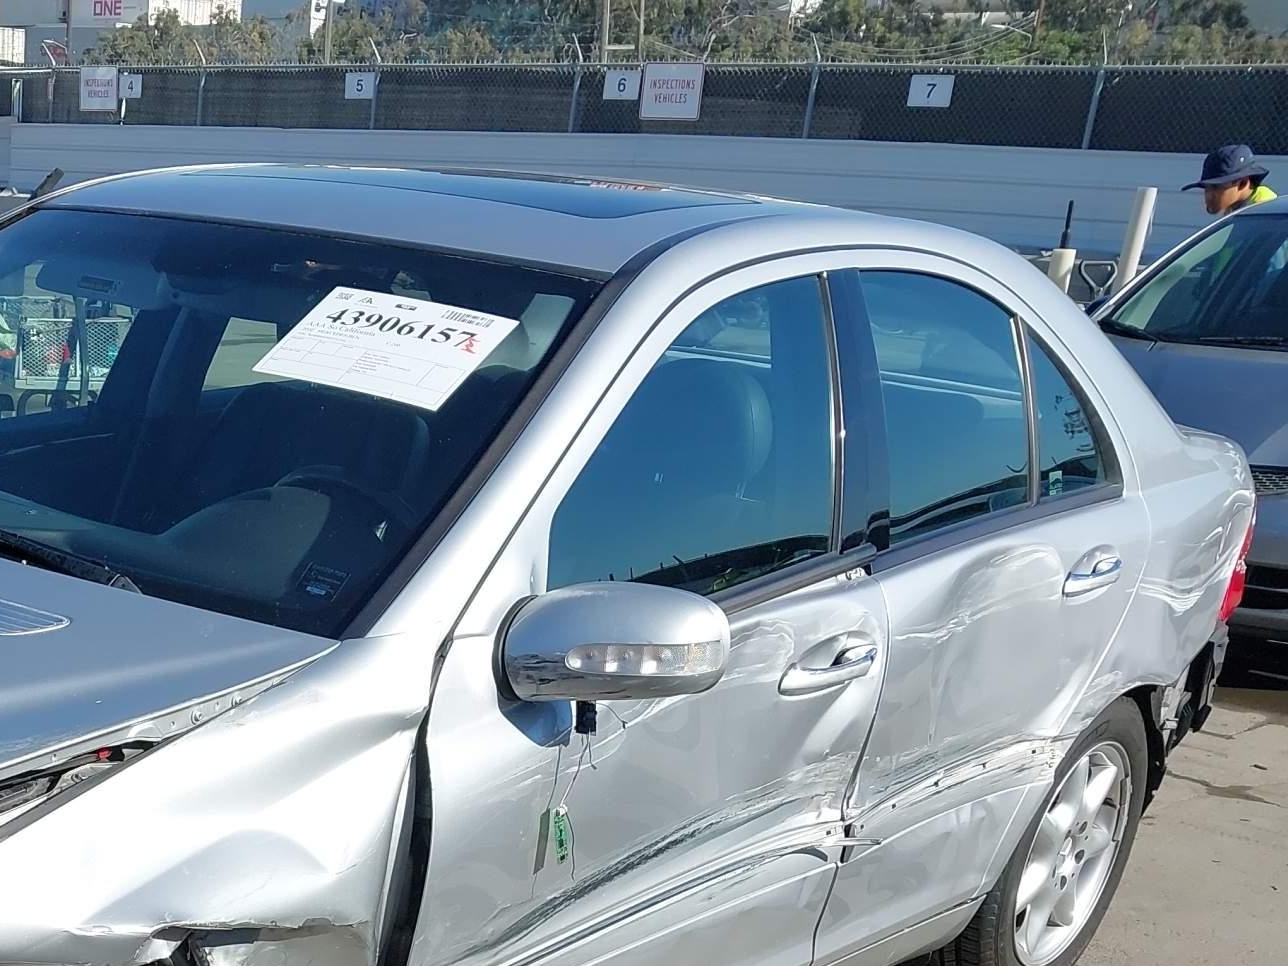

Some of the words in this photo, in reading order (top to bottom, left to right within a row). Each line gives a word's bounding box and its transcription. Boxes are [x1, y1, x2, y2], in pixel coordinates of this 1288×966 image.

[93, 0, 121, 16] ONE
[127, 80, 134, 92] 4
[355, 79, 364, 92] 5
[617, 78, 627, 92] 6
[650, 79, 696, 89] INSPECTIONS
[927, 83, 937, 98] 7
[654, 93, 688, 104] VEHICLES
[326, 308, 478, 348] 43906157
